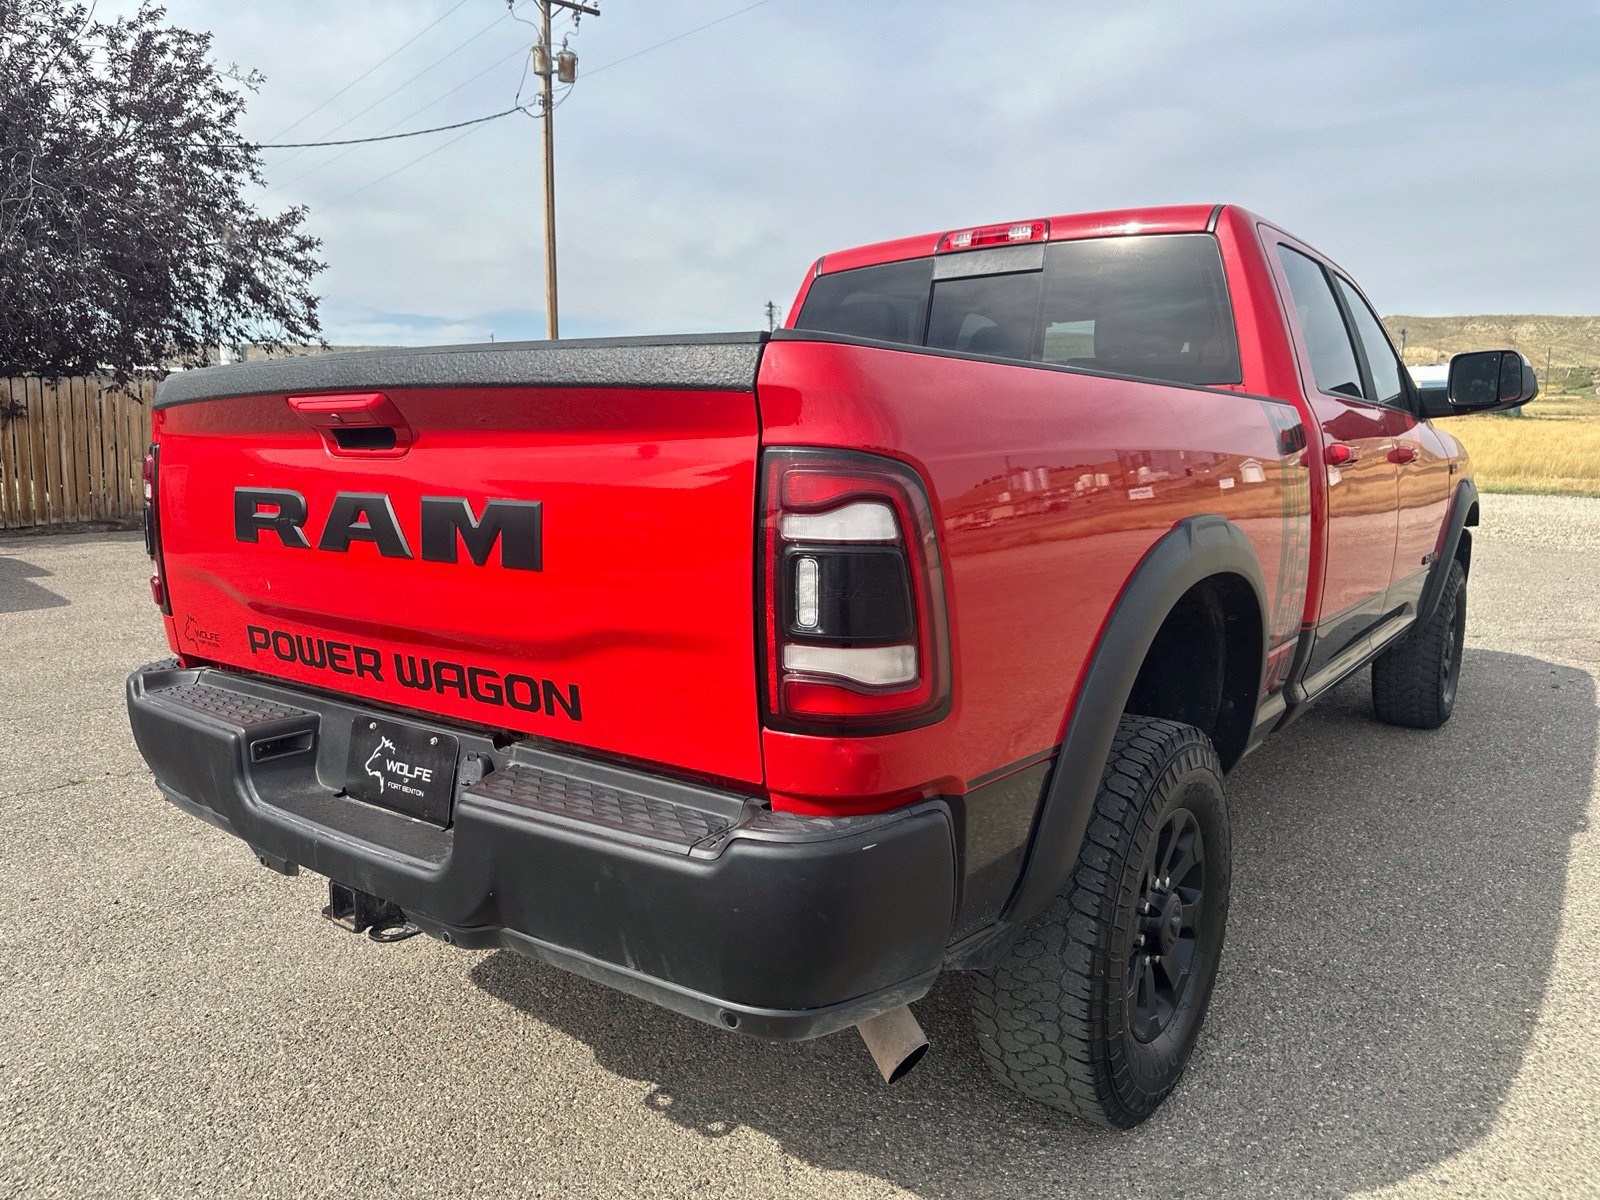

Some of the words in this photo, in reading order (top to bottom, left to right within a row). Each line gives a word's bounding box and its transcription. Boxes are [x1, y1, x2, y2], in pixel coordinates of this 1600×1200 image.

[234, 486, 543, 572] RAM
[194, 629, 221, 643] WOLFE
[247, 625, 384, 682] POWER
[394, 653, 583, 722] WAGON
[386, 758, 433, 782] WOLFE
[387, 781, 402, 791] FORT
[401, 785, 425, 797] BENTON
